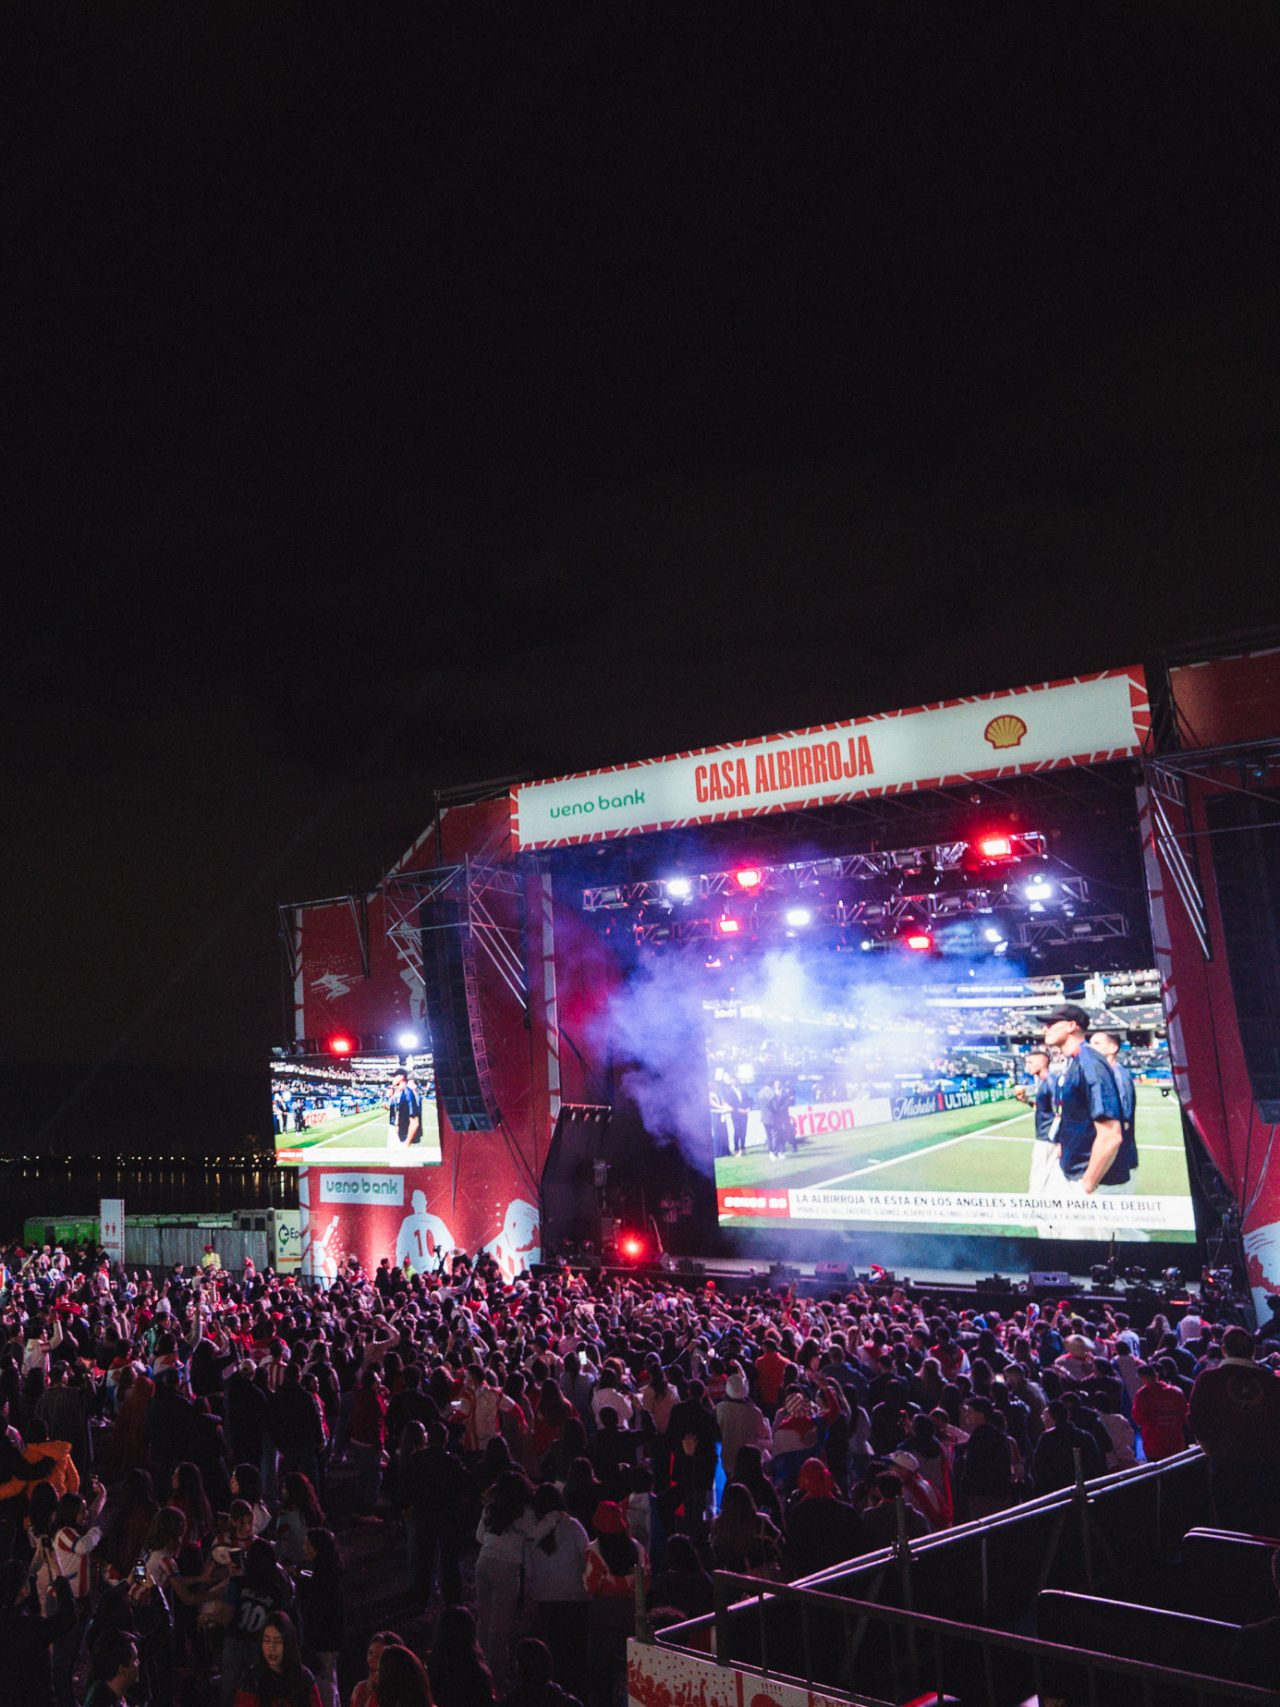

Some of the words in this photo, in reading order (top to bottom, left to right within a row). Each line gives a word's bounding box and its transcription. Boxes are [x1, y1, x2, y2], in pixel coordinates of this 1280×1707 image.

[695, 763, 750, 803] CASA
[755, 735, 874, 794] ALBIRROJA
[550, 797, 595, 819] ueno
[598, 789, 646, 812] bank
[944, 1091, 974, 1110] ULTRA
[326, 1179, 360, 1193] ueno
[362, 1178, 398, 1195] bank
[812, 1195, 865, 1205] ALBIRROJA
[869, 1196, 880, 1205] YA
[914, 1197, 928, 1206] EN
[931, 1198, 952, 1207] LOS
[957, 1198, 1006, 1208] ANGELES
[1011, 1199, 1062, 1210] STADIUM
[1067, 1200, 1098, 1211] PARA
[1102, 1201, 1115, 1211] EL
[1121, 1201, 1162, 1212] DEBUT
